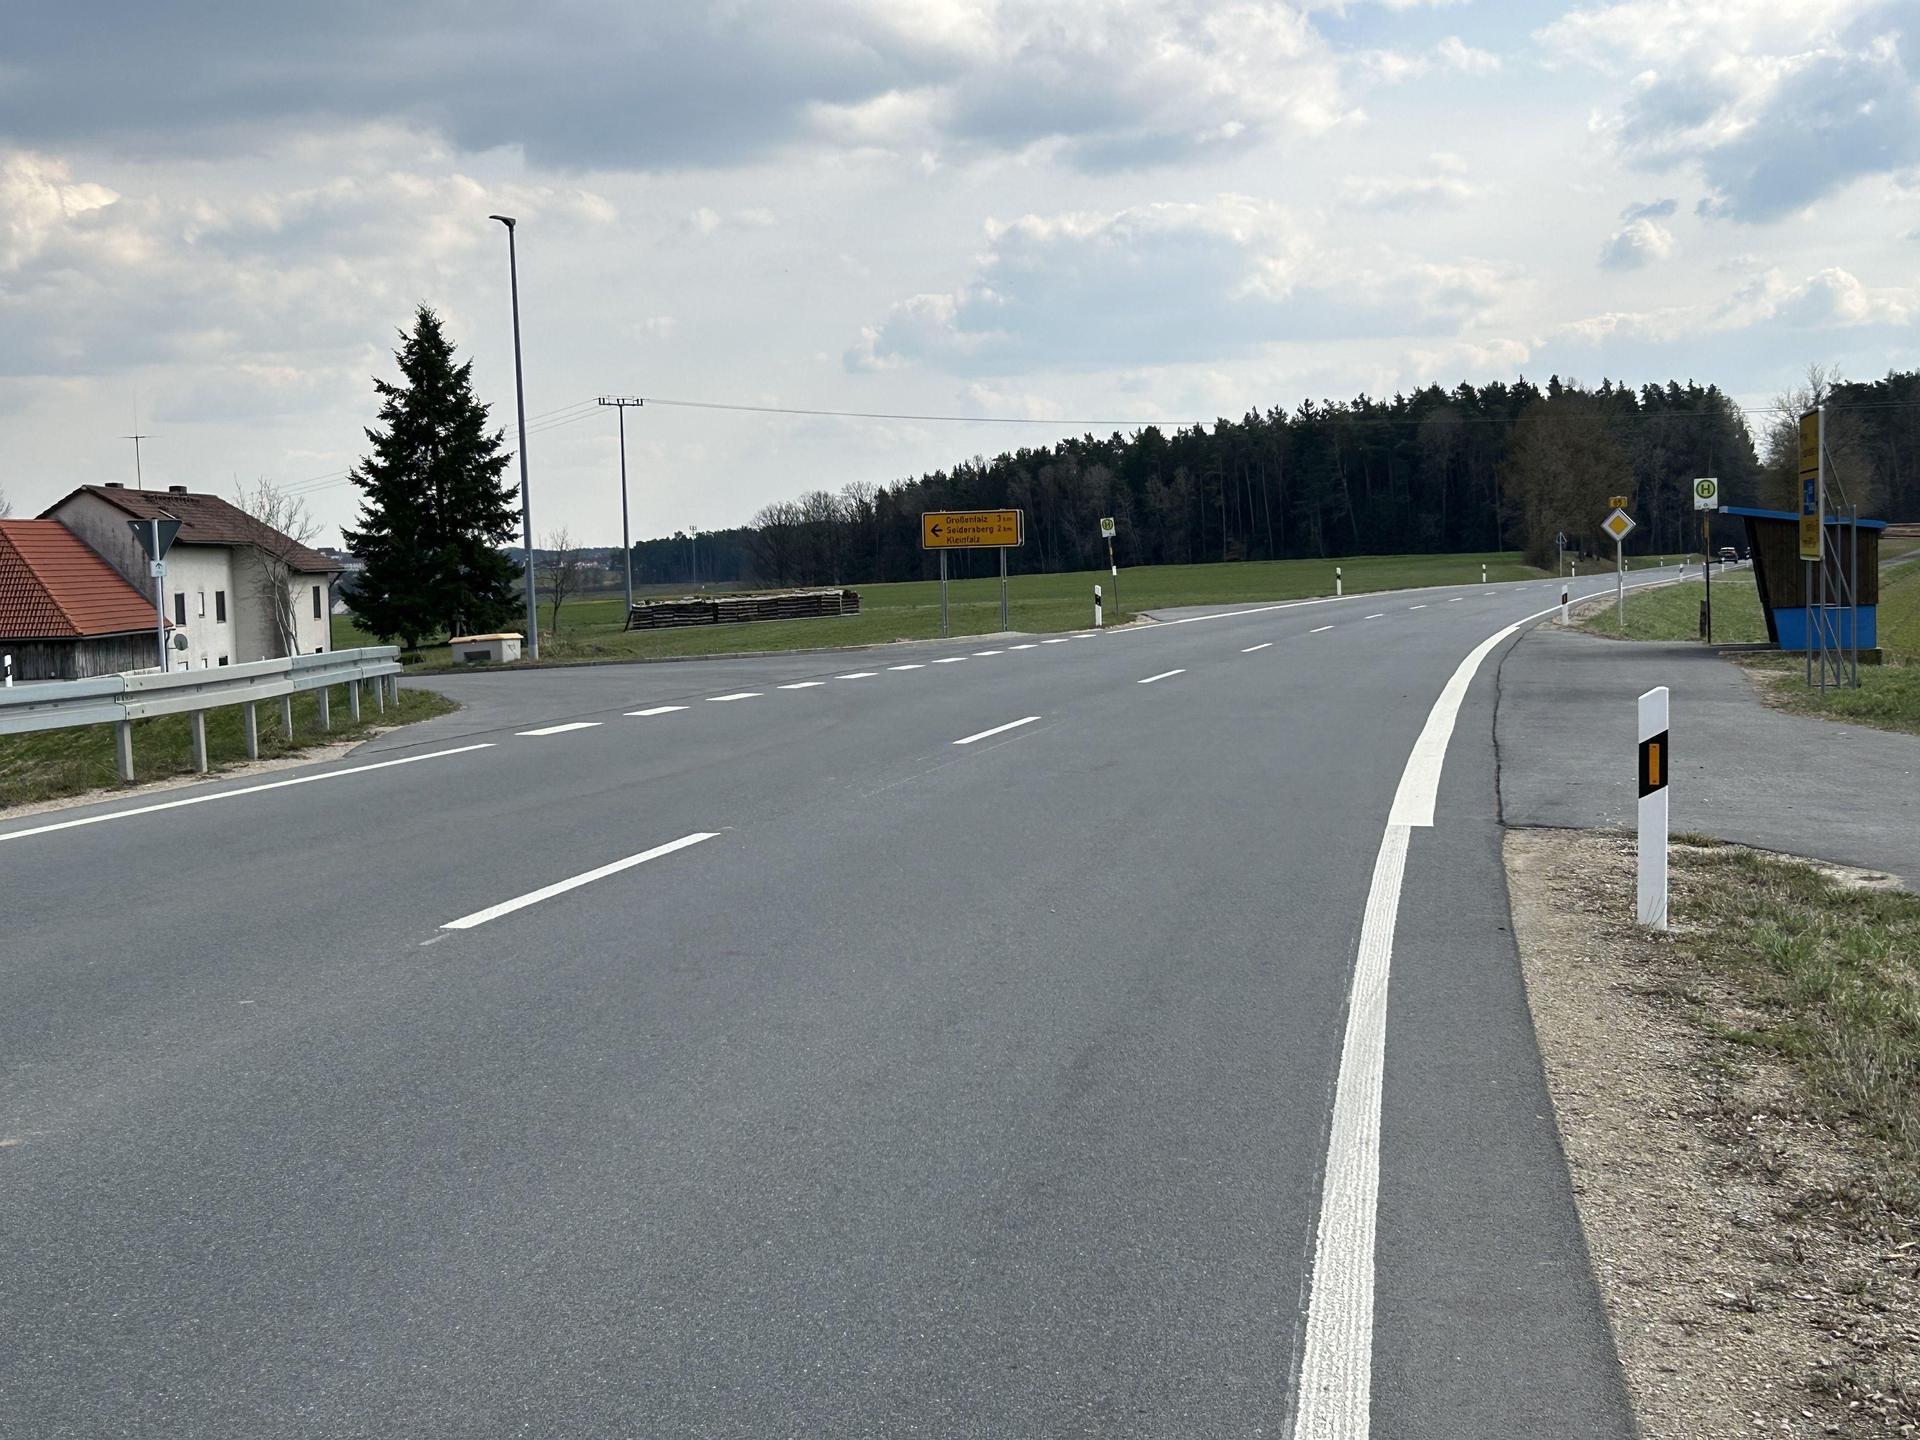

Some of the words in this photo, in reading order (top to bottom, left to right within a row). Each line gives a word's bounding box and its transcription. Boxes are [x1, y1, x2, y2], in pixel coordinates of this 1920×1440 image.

[1701, 484, 1710, 494] H
[946, 515, 988, 524] Großenfalz
[946, 525, 994, 534] Seidersberg
[946, 536, 980, 544] Kleinfalz
